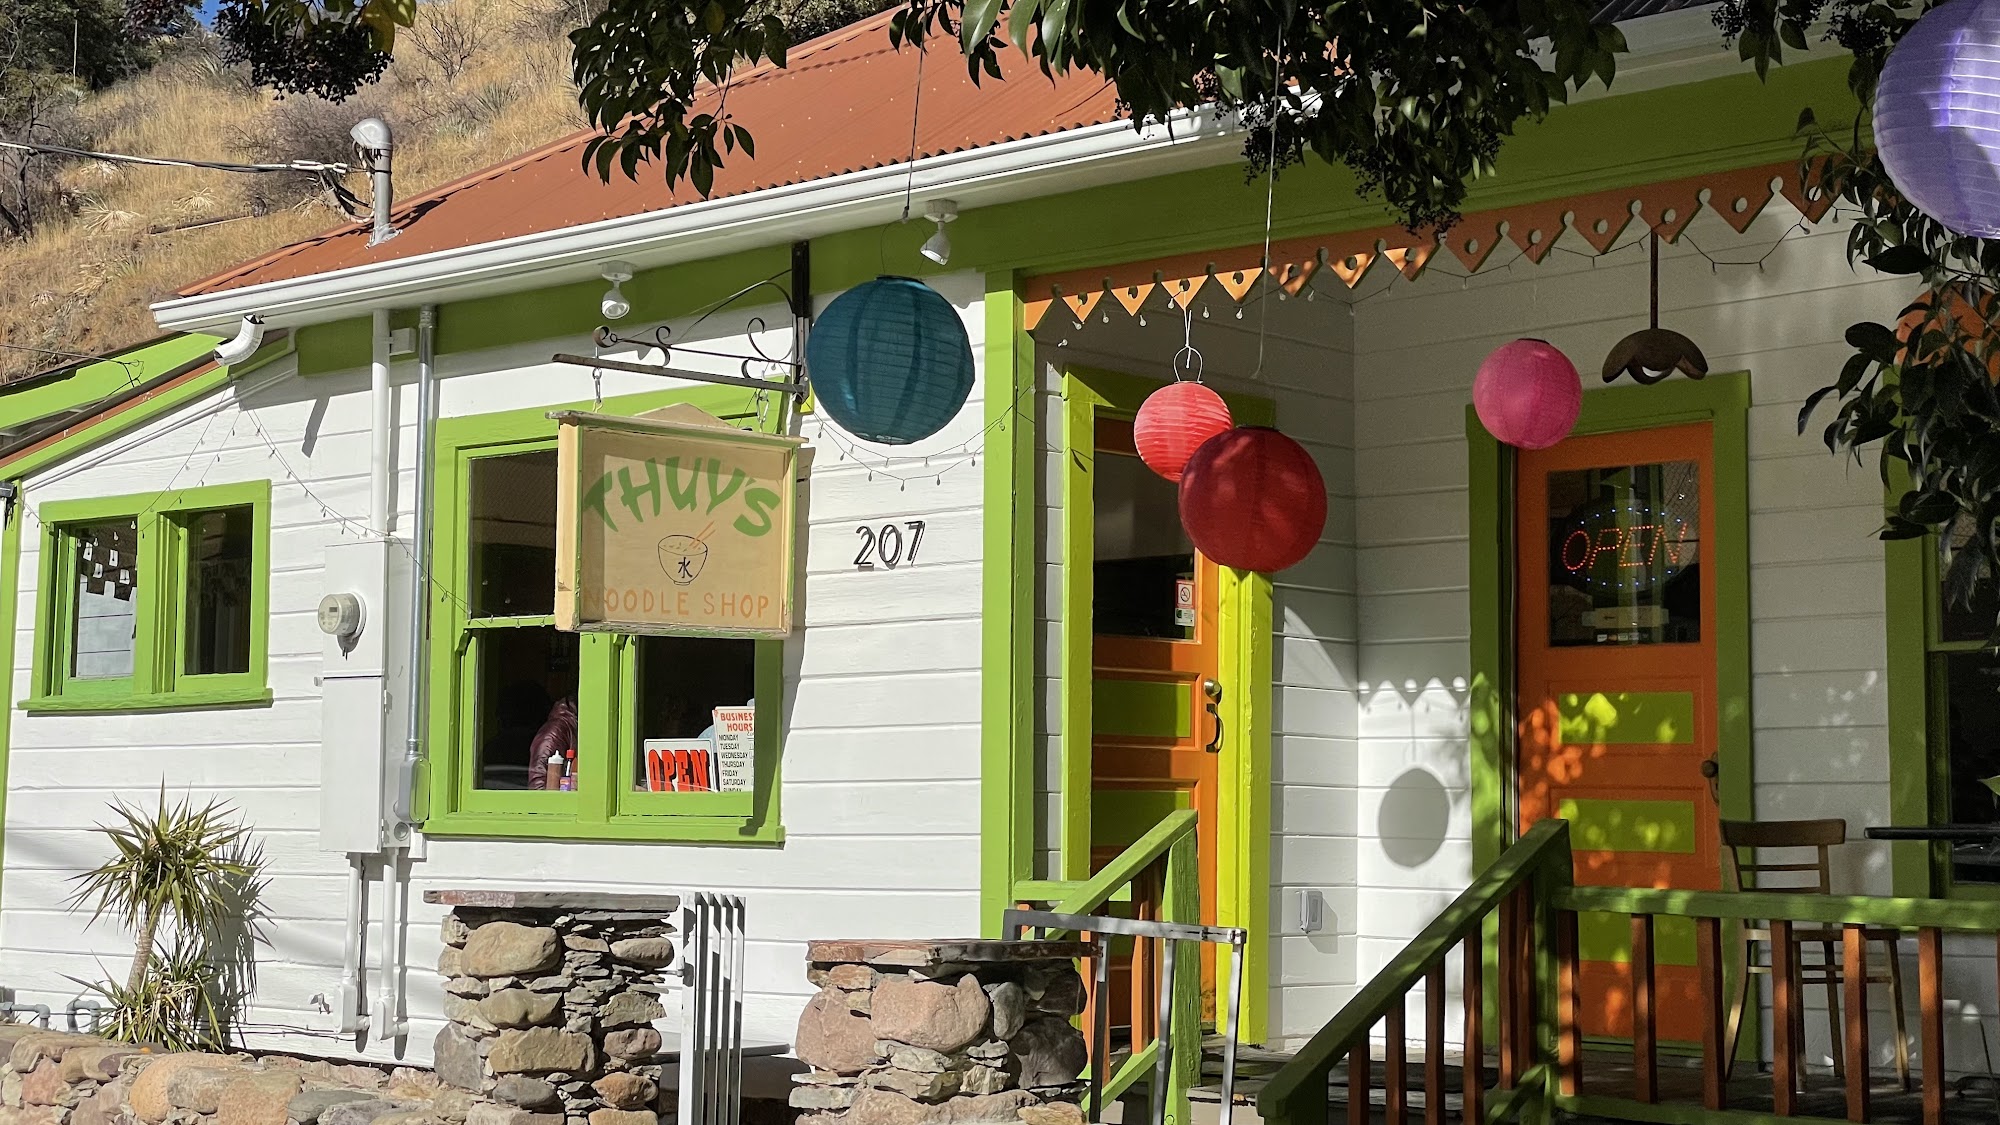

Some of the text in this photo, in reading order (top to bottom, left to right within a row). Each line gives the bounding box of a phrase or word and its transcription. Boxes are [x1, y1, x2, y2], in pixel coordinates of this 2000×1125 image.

[583, 456, 781, 537] THUY'S
[853, 520, 926, 568] 207
[1562, 523, 1687, 570] OPEN
[583, 586, 769, 619] NOODLE SHOP
[721, 712, 755, 721] BUSINES
[727, 723, 753, 732] HOURS
[648, 749, 709, 792] OPEN
[722, 769, 738, 777] FRIDAY
[723, 778, 746, 786] SATURDAY
